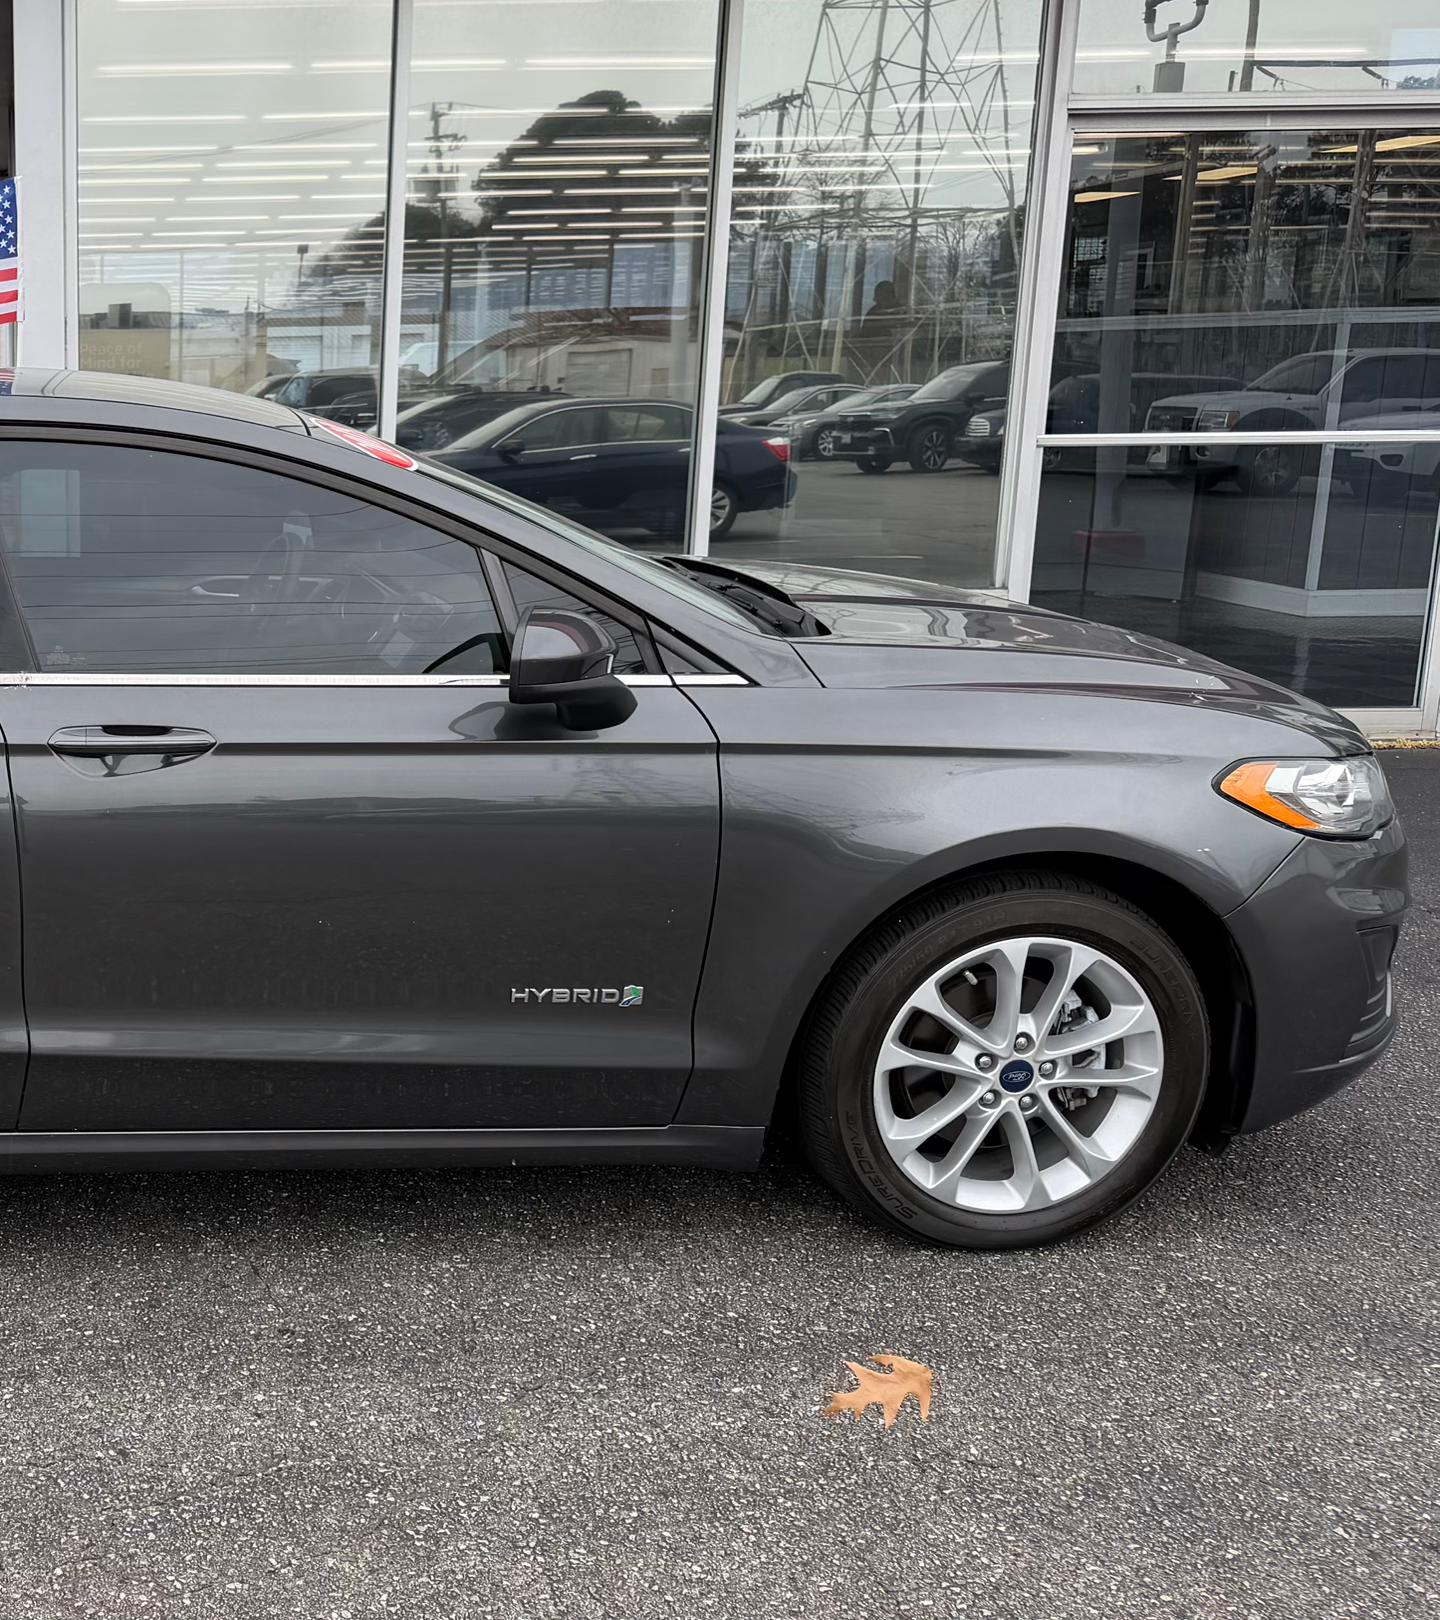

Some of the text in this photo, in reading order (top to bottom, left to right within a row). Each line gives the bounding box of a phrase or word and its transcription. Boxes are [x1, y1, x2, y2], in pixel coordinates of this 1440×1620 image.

[127, 341, 144, 354] of
[79, 356, 143, 369] Mind for
[511, 988, 620, 1003] HYBRID
